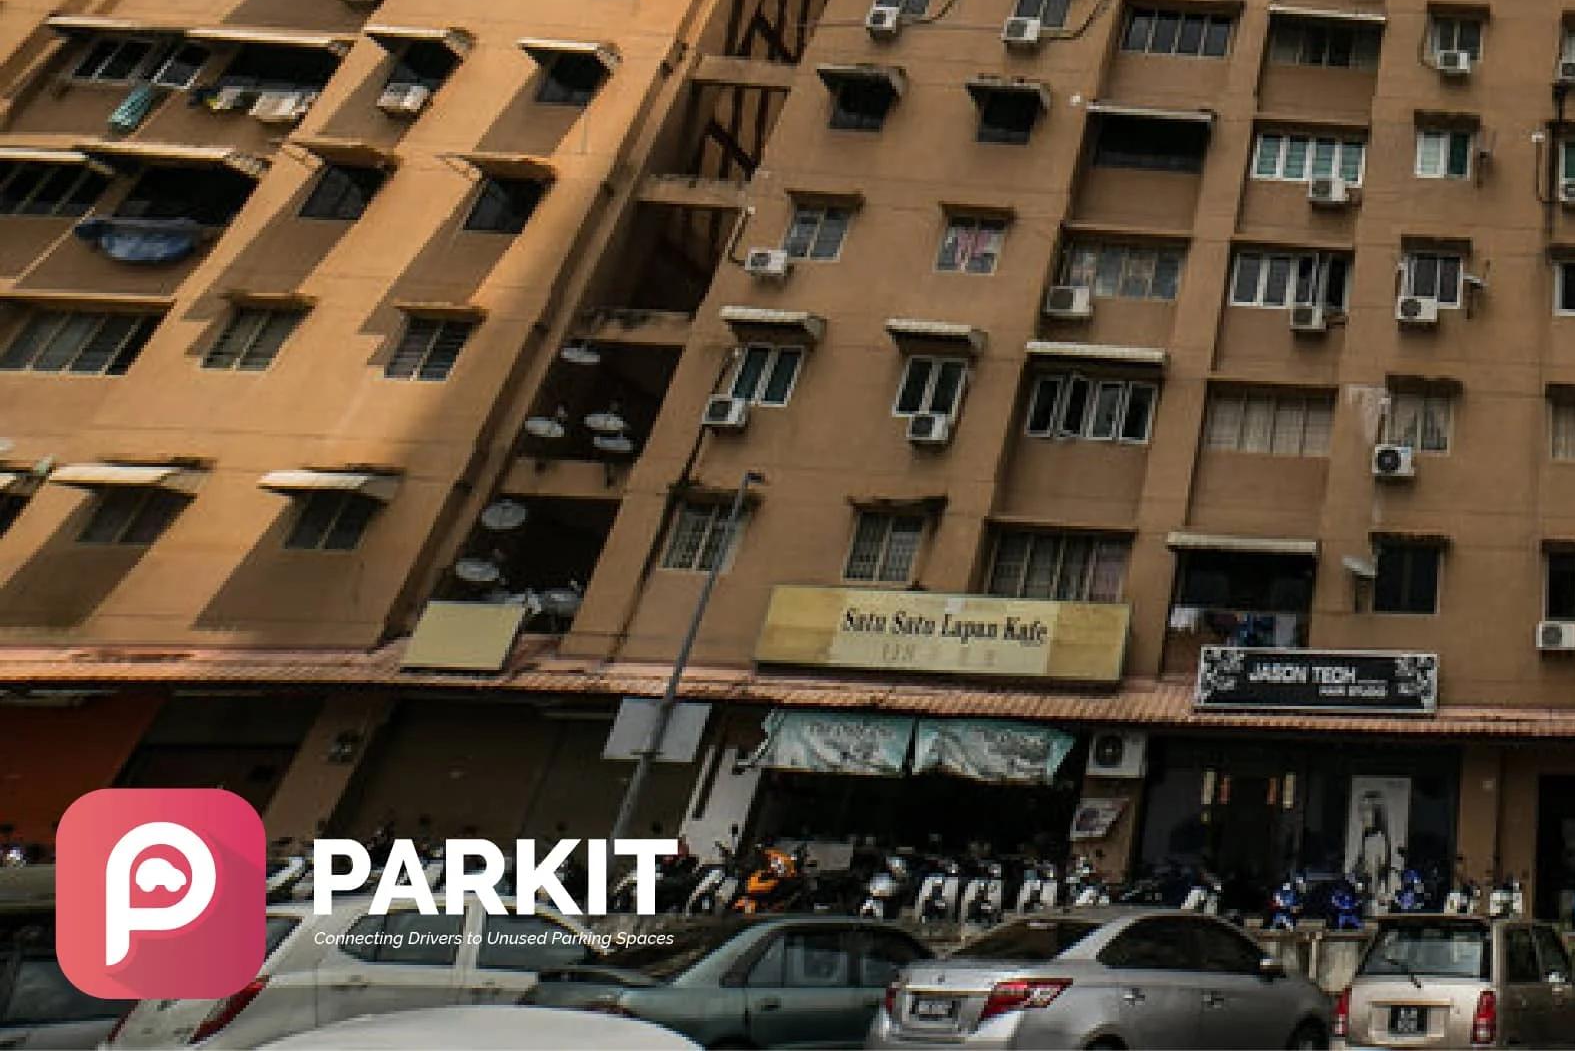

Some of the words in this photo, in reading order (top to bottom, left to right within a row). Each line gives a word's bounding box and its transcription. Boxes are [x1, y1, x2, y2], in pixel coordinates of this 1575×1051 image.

[841, 607, 887, 632] Satu
[891, 609, 935, 635] Satu
[941, 613, 997, 644] Lapan
[1003, 615, 1048, 643] Kafe
[1249, 662, 1307, 684] JASON
